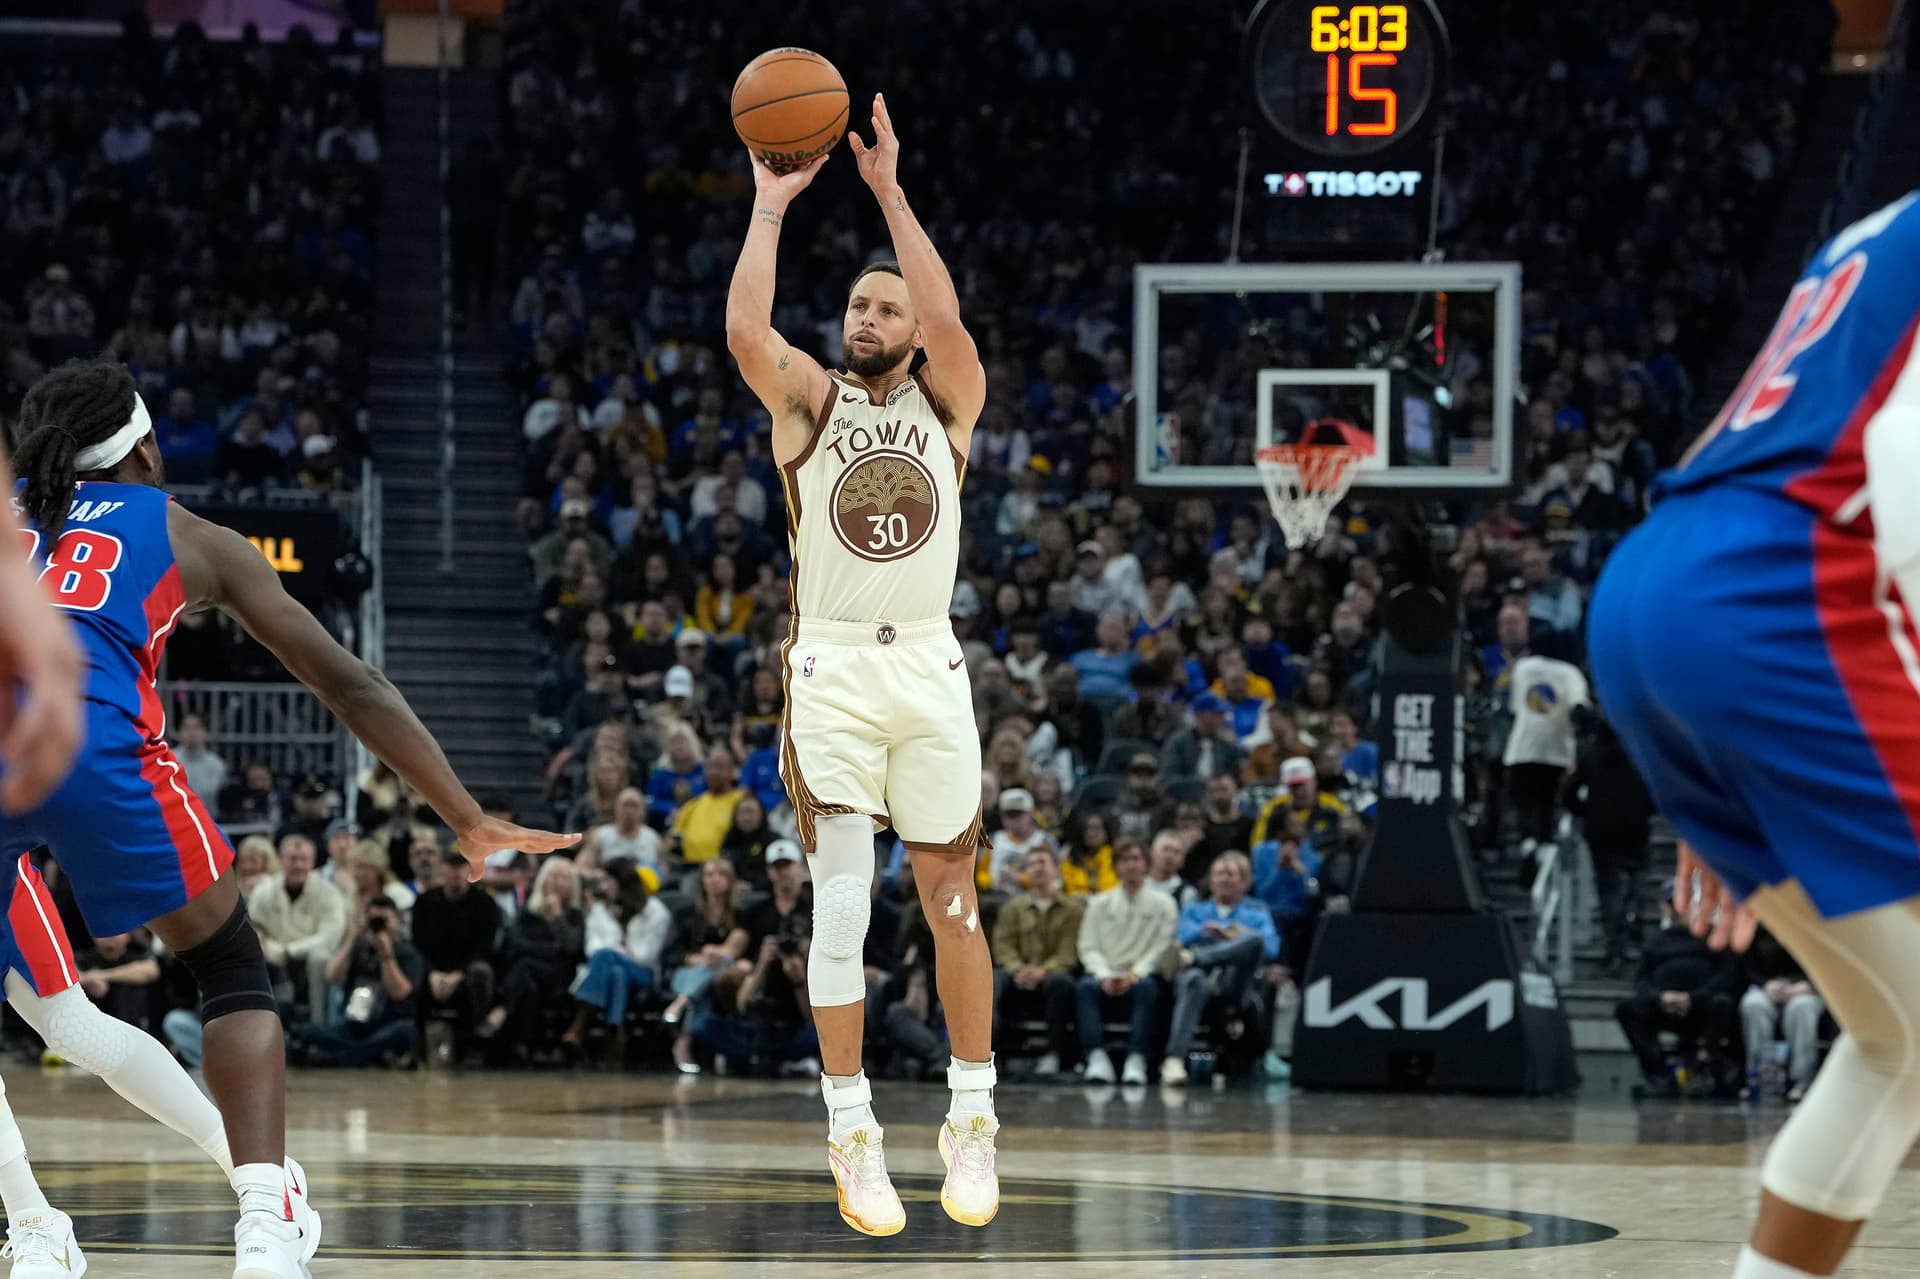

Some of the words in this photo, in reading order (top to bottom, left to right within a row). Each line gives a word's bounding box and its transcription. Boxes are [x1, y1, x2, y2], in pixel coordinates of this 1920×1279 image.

[1311, 5, 1407, 52] 6:03
[1325, 53, 1397, 135] 15
[1306, 171, 1421, 196] TISSOT
[826, 420, 929, 465] TOWN
[832, 417, 854, 435] The
[866, 512, 909, 550] 30
[1394, 694, 1435, 728] GET
[1393, 729, 1434, 762] THE
[1304, 975, 1514, 1032] KIA
